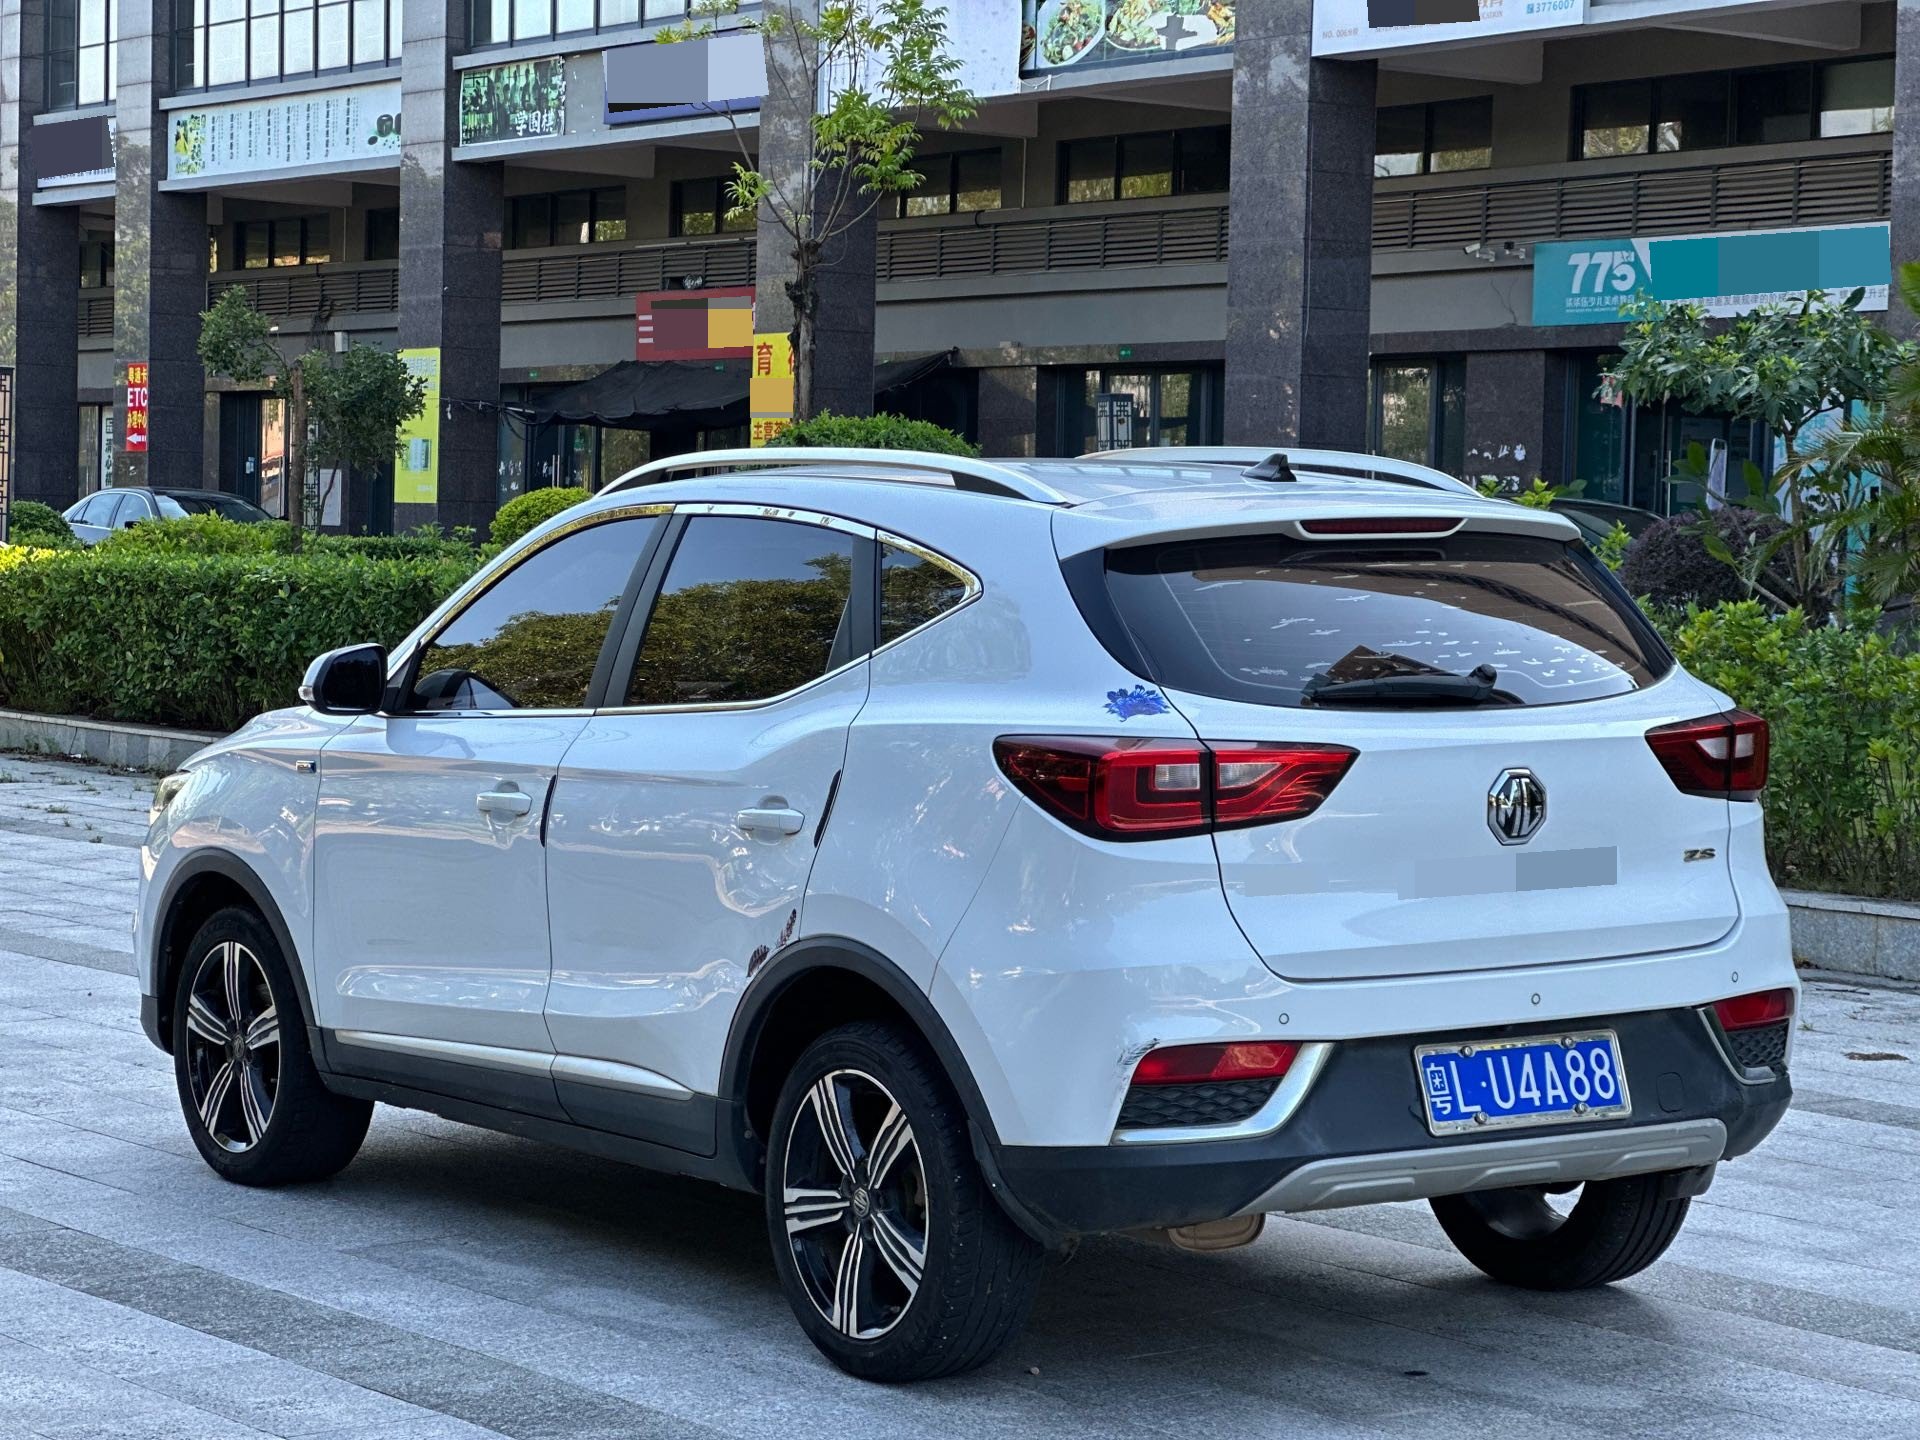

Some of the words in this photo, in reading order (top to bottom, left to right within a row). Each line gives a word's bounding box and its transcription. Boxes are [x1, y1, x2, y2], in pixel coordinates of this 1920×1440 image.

[1535, 0, 1575, 13] 3776007
[1567, 251, 1636, 294] 775
[127, 387, 148, 407] ETC
[753, 420, 791, 440] 主营茶
[1497, 779, 1543, 837] MG
[1684, 849, 1716, 862] ZS
